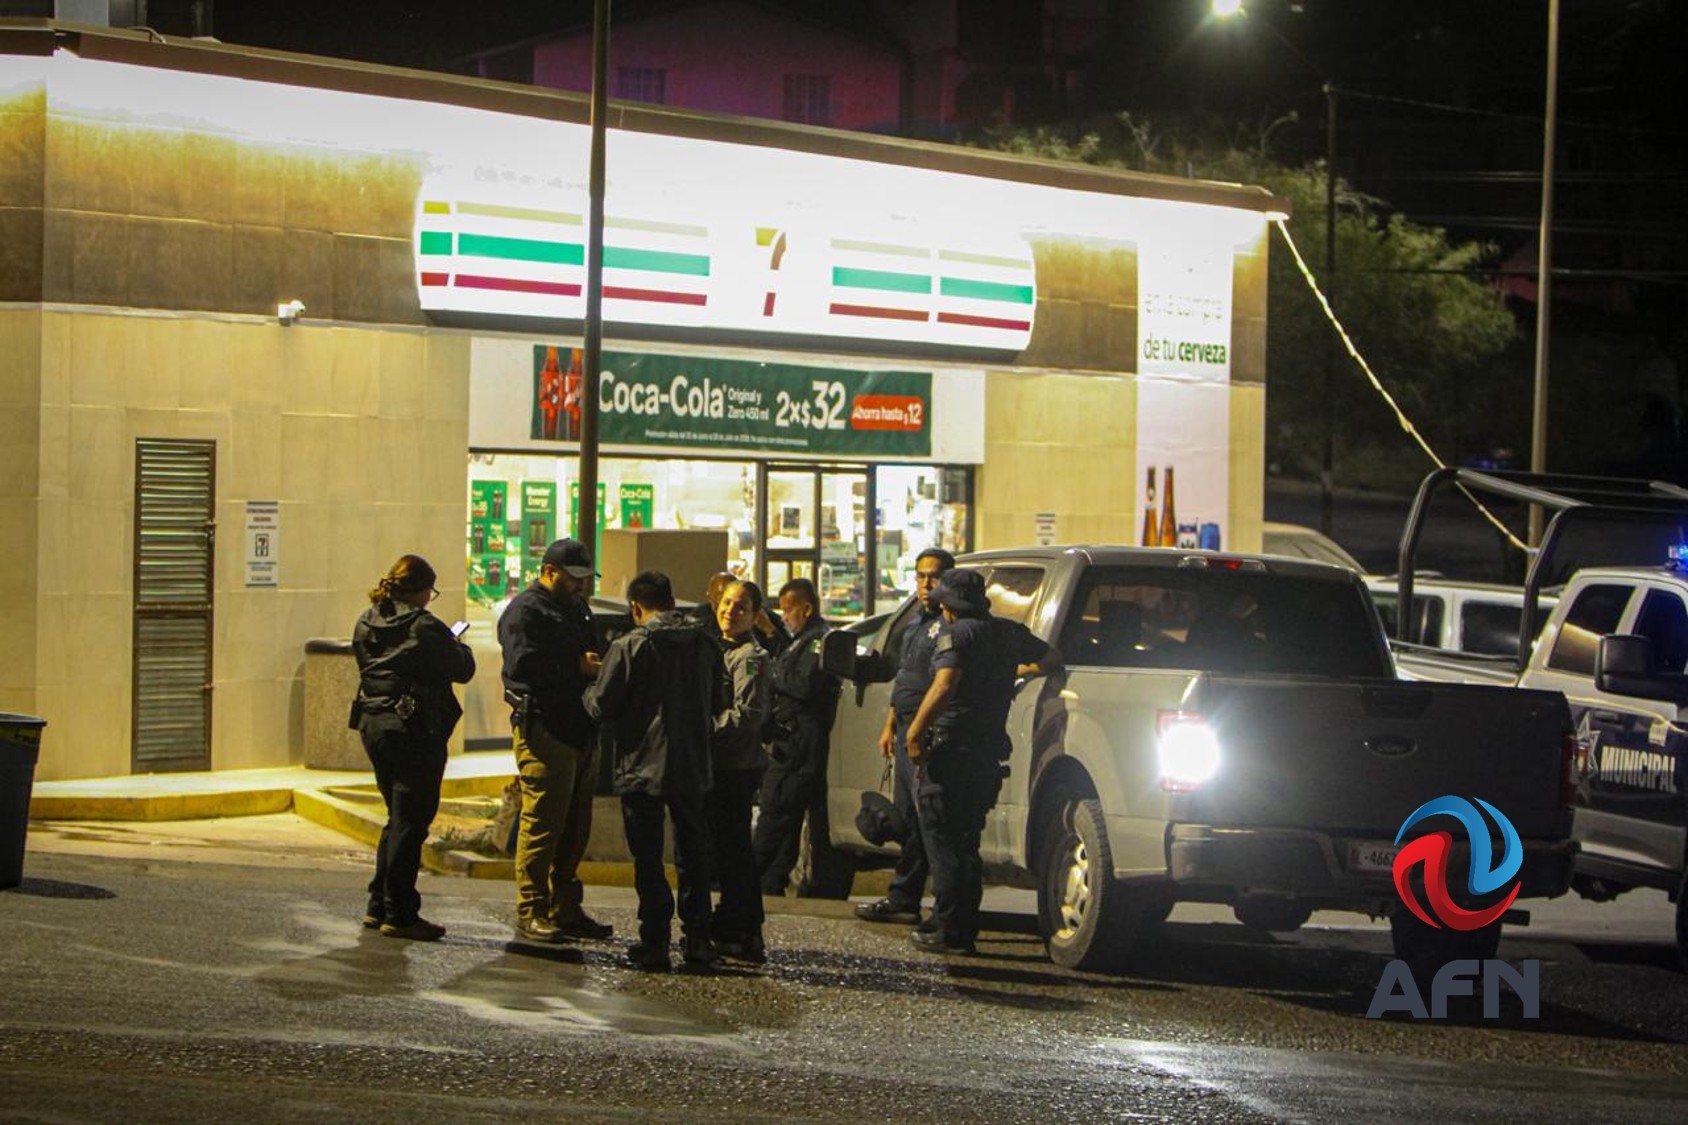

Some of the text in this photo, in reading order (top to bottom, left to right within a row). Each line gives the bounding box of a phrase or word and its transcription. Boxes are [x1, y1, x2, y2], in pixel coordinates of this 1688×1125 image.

[1144, 331, 1227, 365] de tu cerveza
[598, 370, 725, 419] Coca-Cola
[728, 388, 756, 404] Original
[728, 405, 745, 419] Zero
[852, 405, 881, 420] Ahorra
[881, 406, 903, 422] hasta
[1601, 746, 1677, 793] MUNICIPAL
